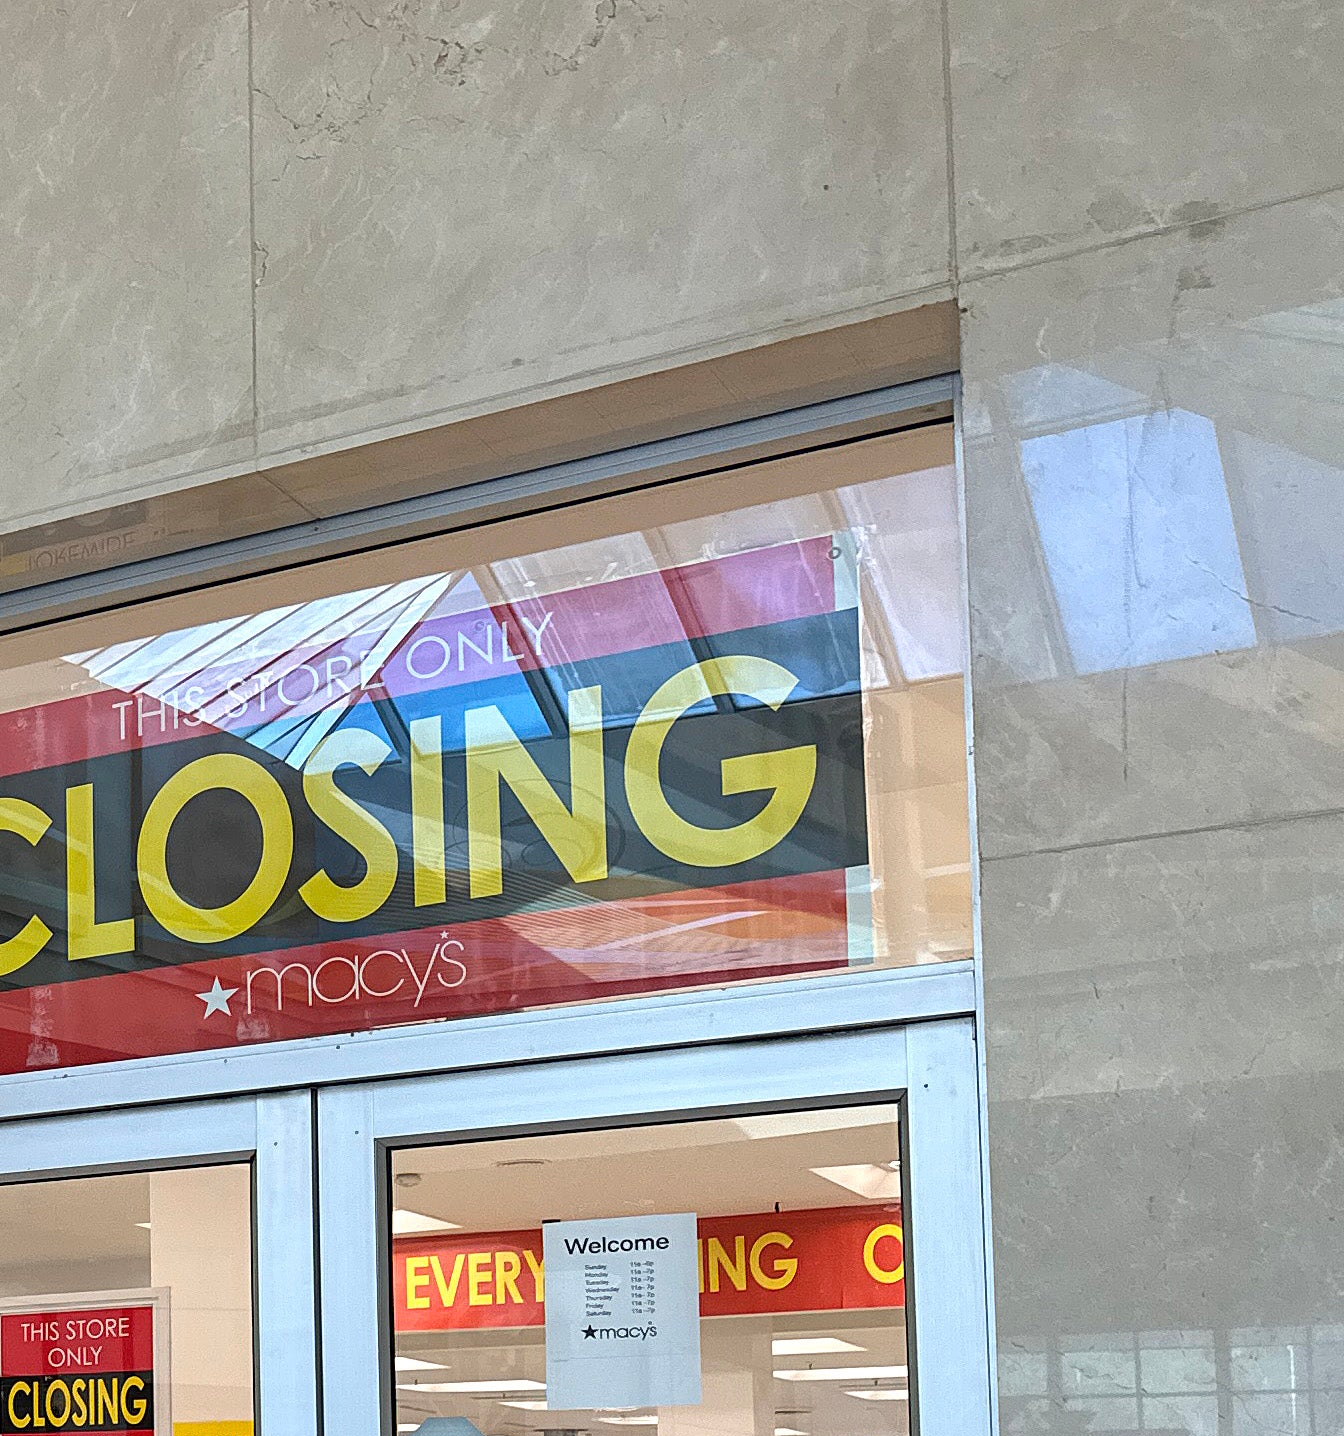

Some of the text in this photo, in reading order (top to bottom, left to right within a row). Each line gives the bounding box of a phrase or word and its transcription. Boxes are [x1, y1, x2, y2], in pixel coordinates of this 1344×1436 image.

[111, 611, 554, 742] THIS STORE ONLY
[245, 930, 468, 1018] macy's
[564, 1236, 670, 1255] Welcome
[21, 1317, 130, 1342] THIS STORE
[599, 1321, 658, 1341] macy's
[48, 1346, 102, 1367] ONLY
[8, 1376, 147, 1429] CLOSING
